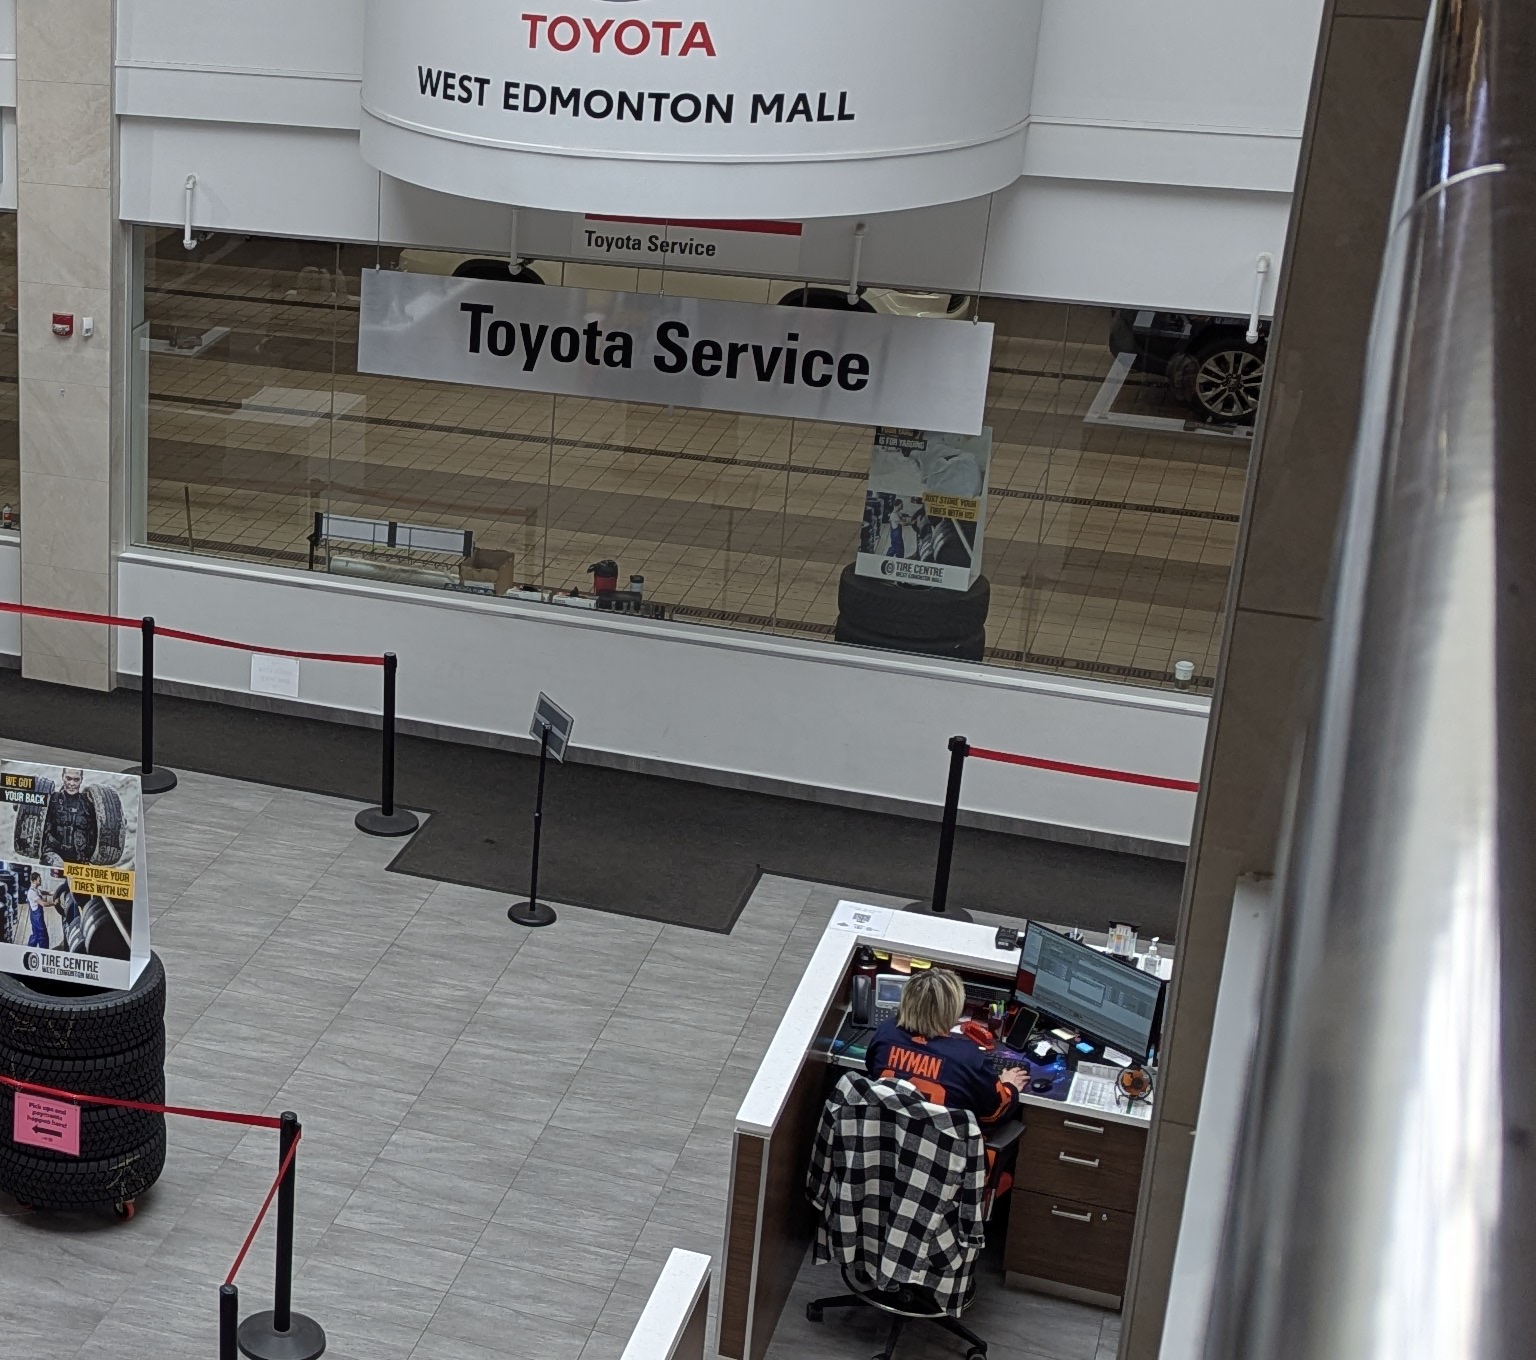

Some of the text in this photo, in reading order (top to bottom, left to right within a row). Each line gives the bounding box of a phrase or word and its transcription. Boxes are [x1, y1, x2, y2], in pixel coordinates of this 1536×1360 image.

[521, 13, 717, 57] TOYOTA
[417, 65, 855, 124] WEST EDMONTON MALL
[585, 230, 716, 256] Toyota Service
[460, 302, 871, 392] Toyota Service
[896, 561, 943, 577] TIRE CENTRE
[5, 775, 33, 789] WE GOT
[4, 790, 46, 805] YOUR BACK
[66, 864, 130, 883] JUST STORE YOUR
[74, 880, 94, 893] TIRES
[96, 882, 116, 896] WITH
[41, 953, 99, 973] TIRE CENTRE
[888, 1045, 943, 1080] HYMAN
